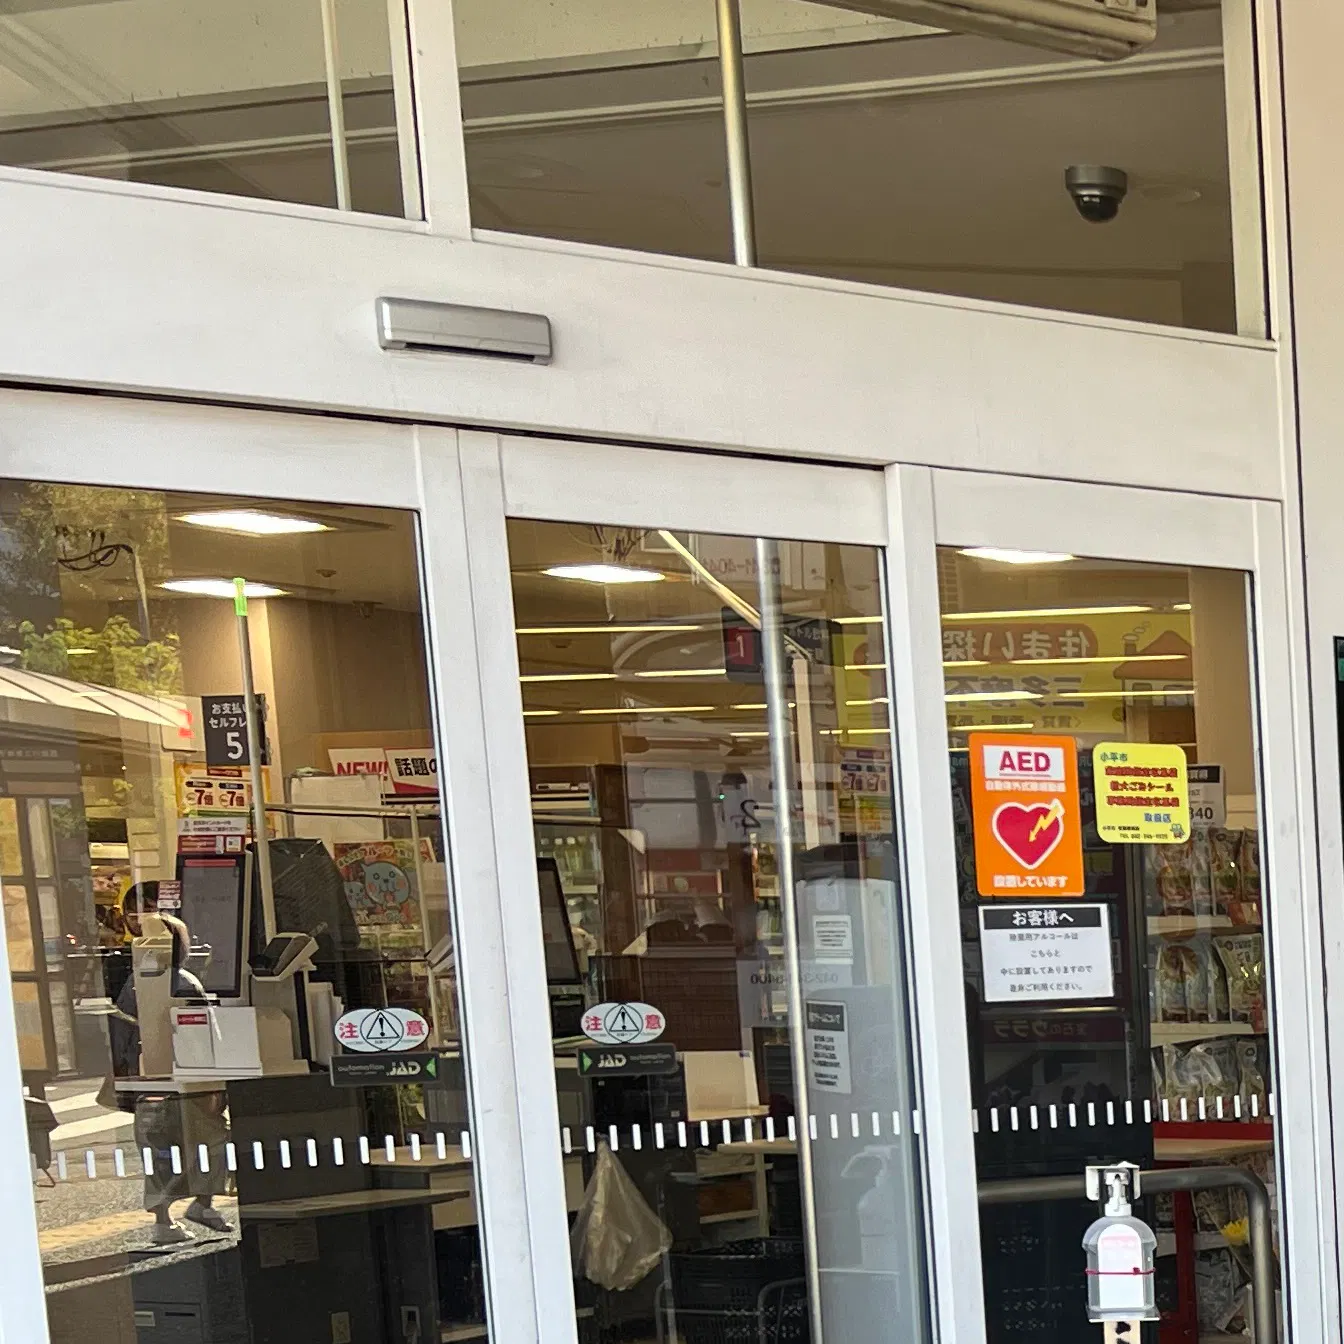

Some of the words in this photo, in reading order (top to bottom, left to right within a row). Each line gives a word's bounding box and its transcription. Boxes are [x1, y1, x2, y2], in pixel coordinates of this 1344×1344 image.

[208, 717, 247, 728] セルフレ
[226, 731, 243, 760] 5
[999, 750, 1051, 772] AED
[1011, 909, 1075, 927] お客様へ
[1030, 949, 1061, 958] こちらと
[339, 1022, 359, 1039] 注
[585, 1015, 603, 1031] 注
